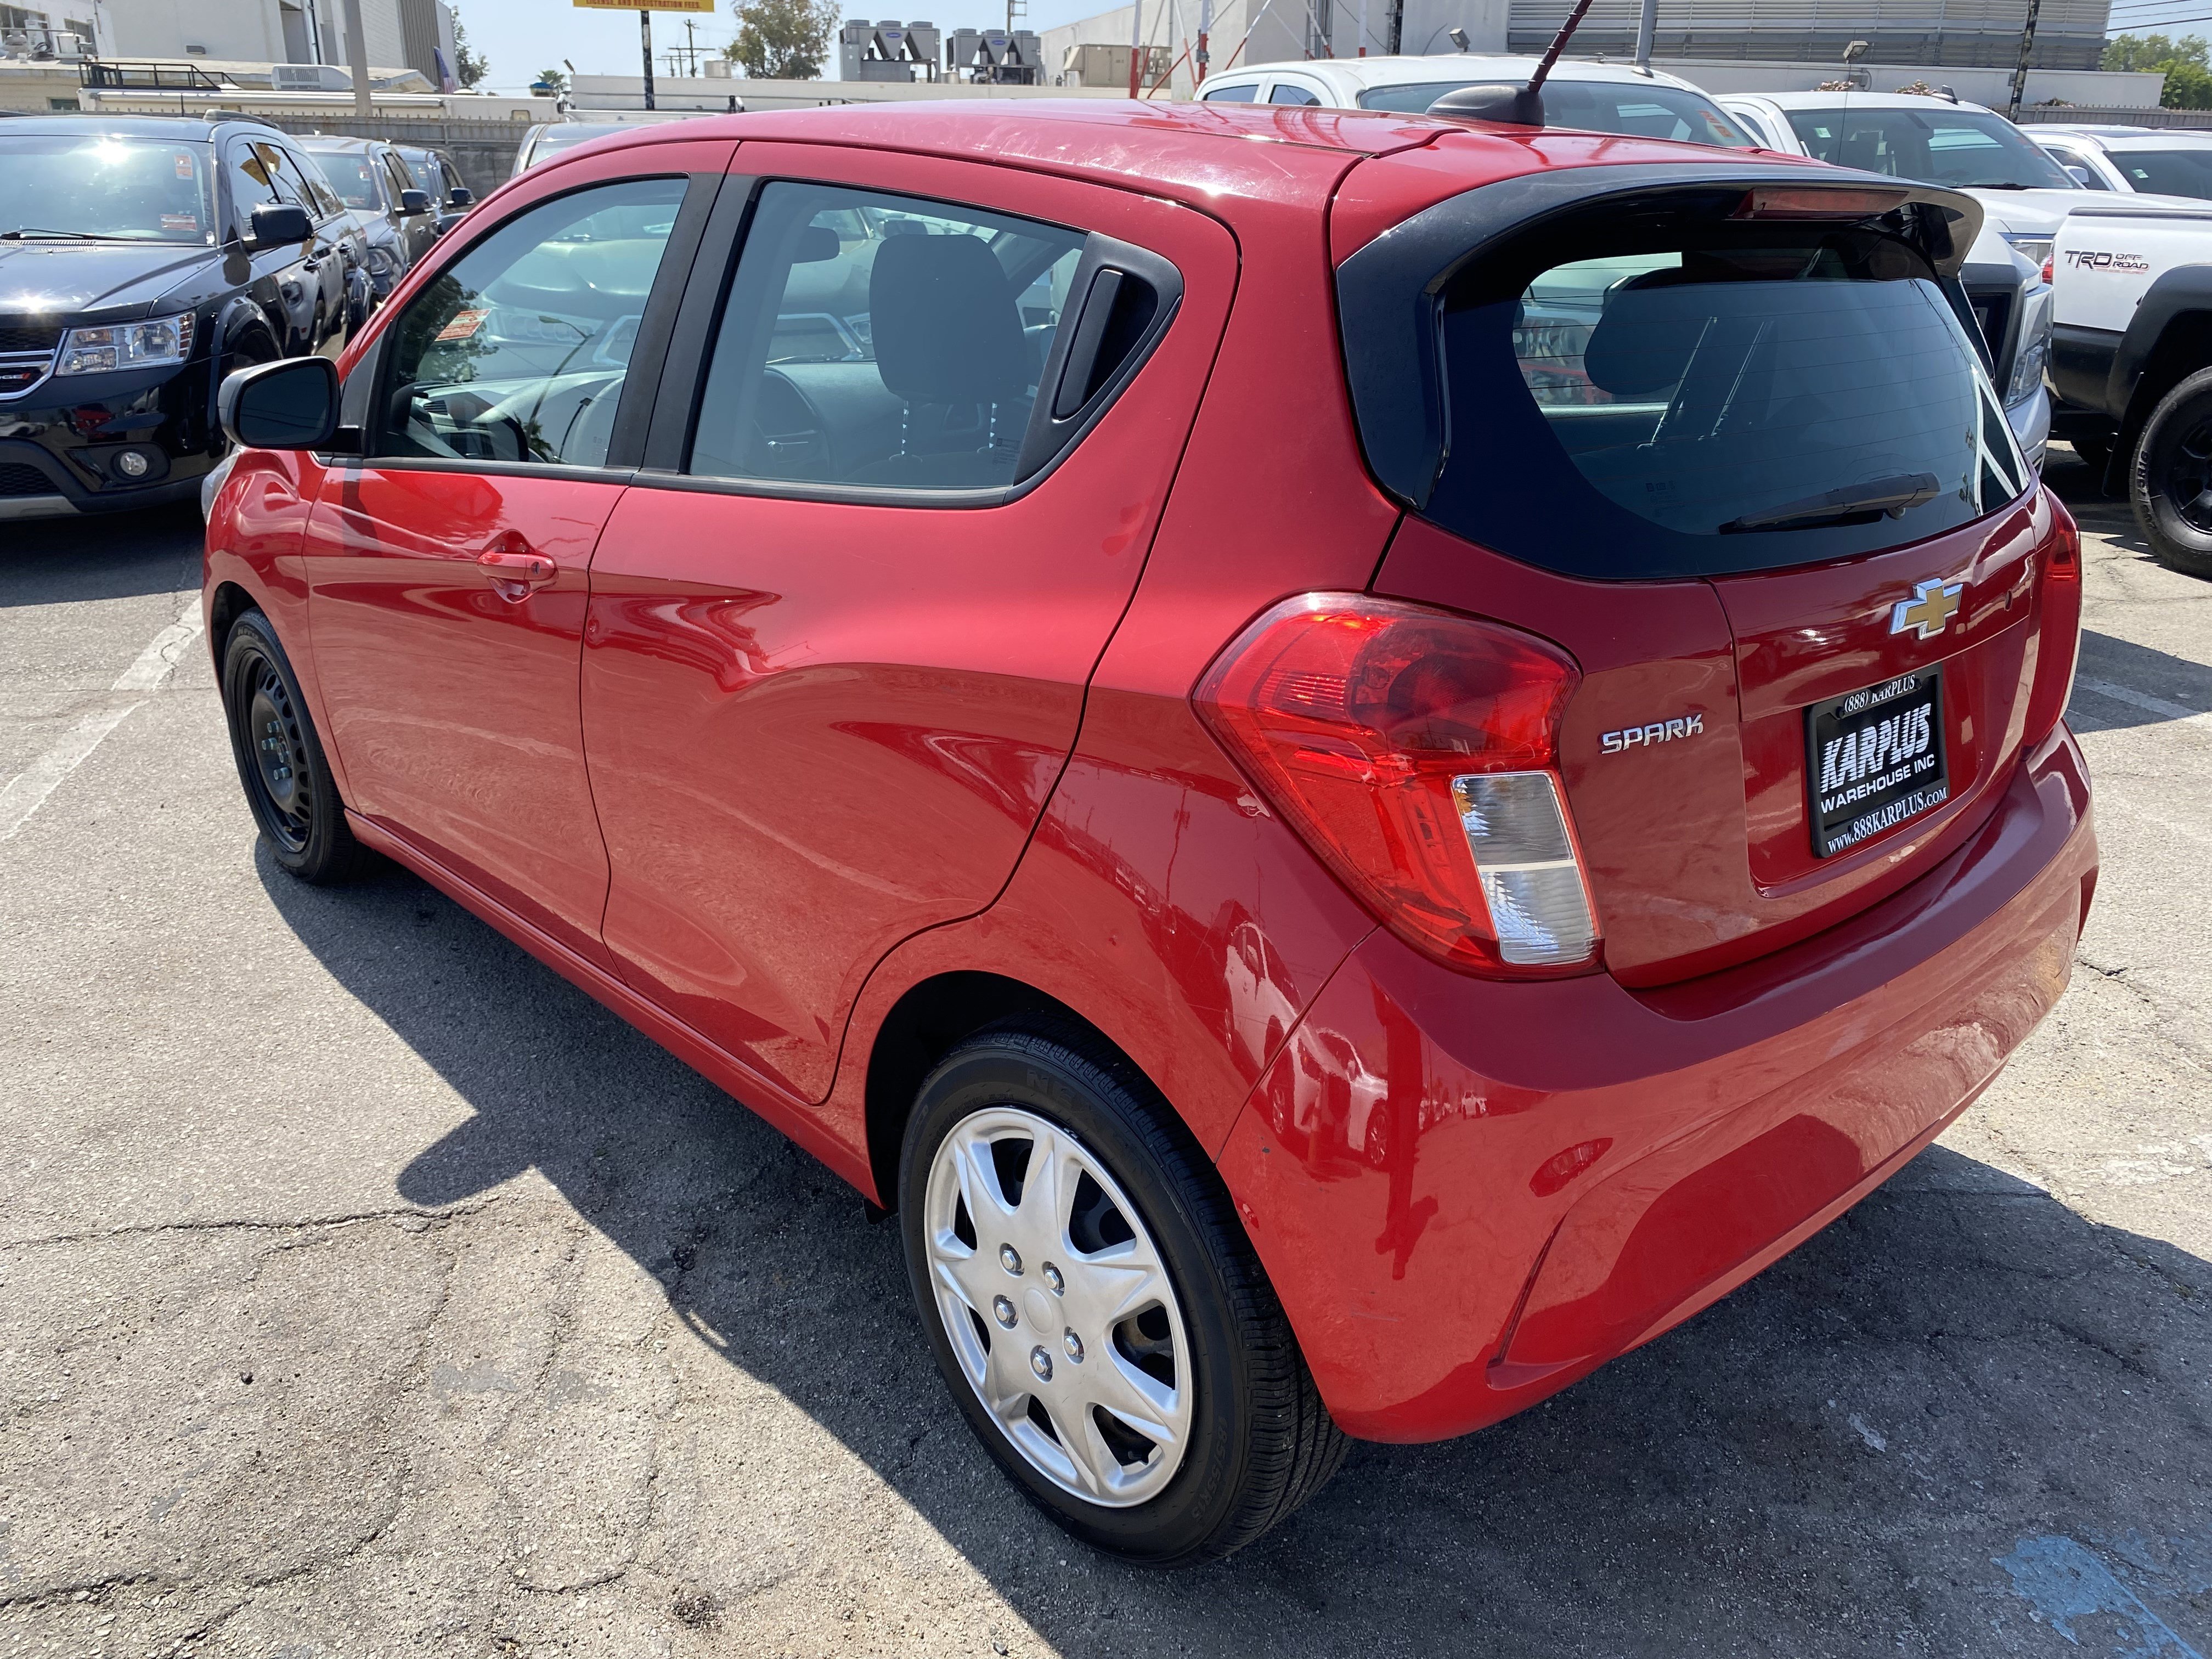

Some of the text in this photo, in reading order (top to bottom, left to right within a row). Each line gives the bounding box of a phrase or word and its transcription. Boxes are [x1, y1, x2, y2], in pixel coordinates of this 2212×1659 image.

[2065, 250, 2112, 269] TRD
[1844, 691, 1869, 713] (888)
[1601, 714, 1704, 754] SPARK
[1820, 703, 1932, 793] KARPLUS
[1821, 754, 1935, 814] WAREHOUSE INC
